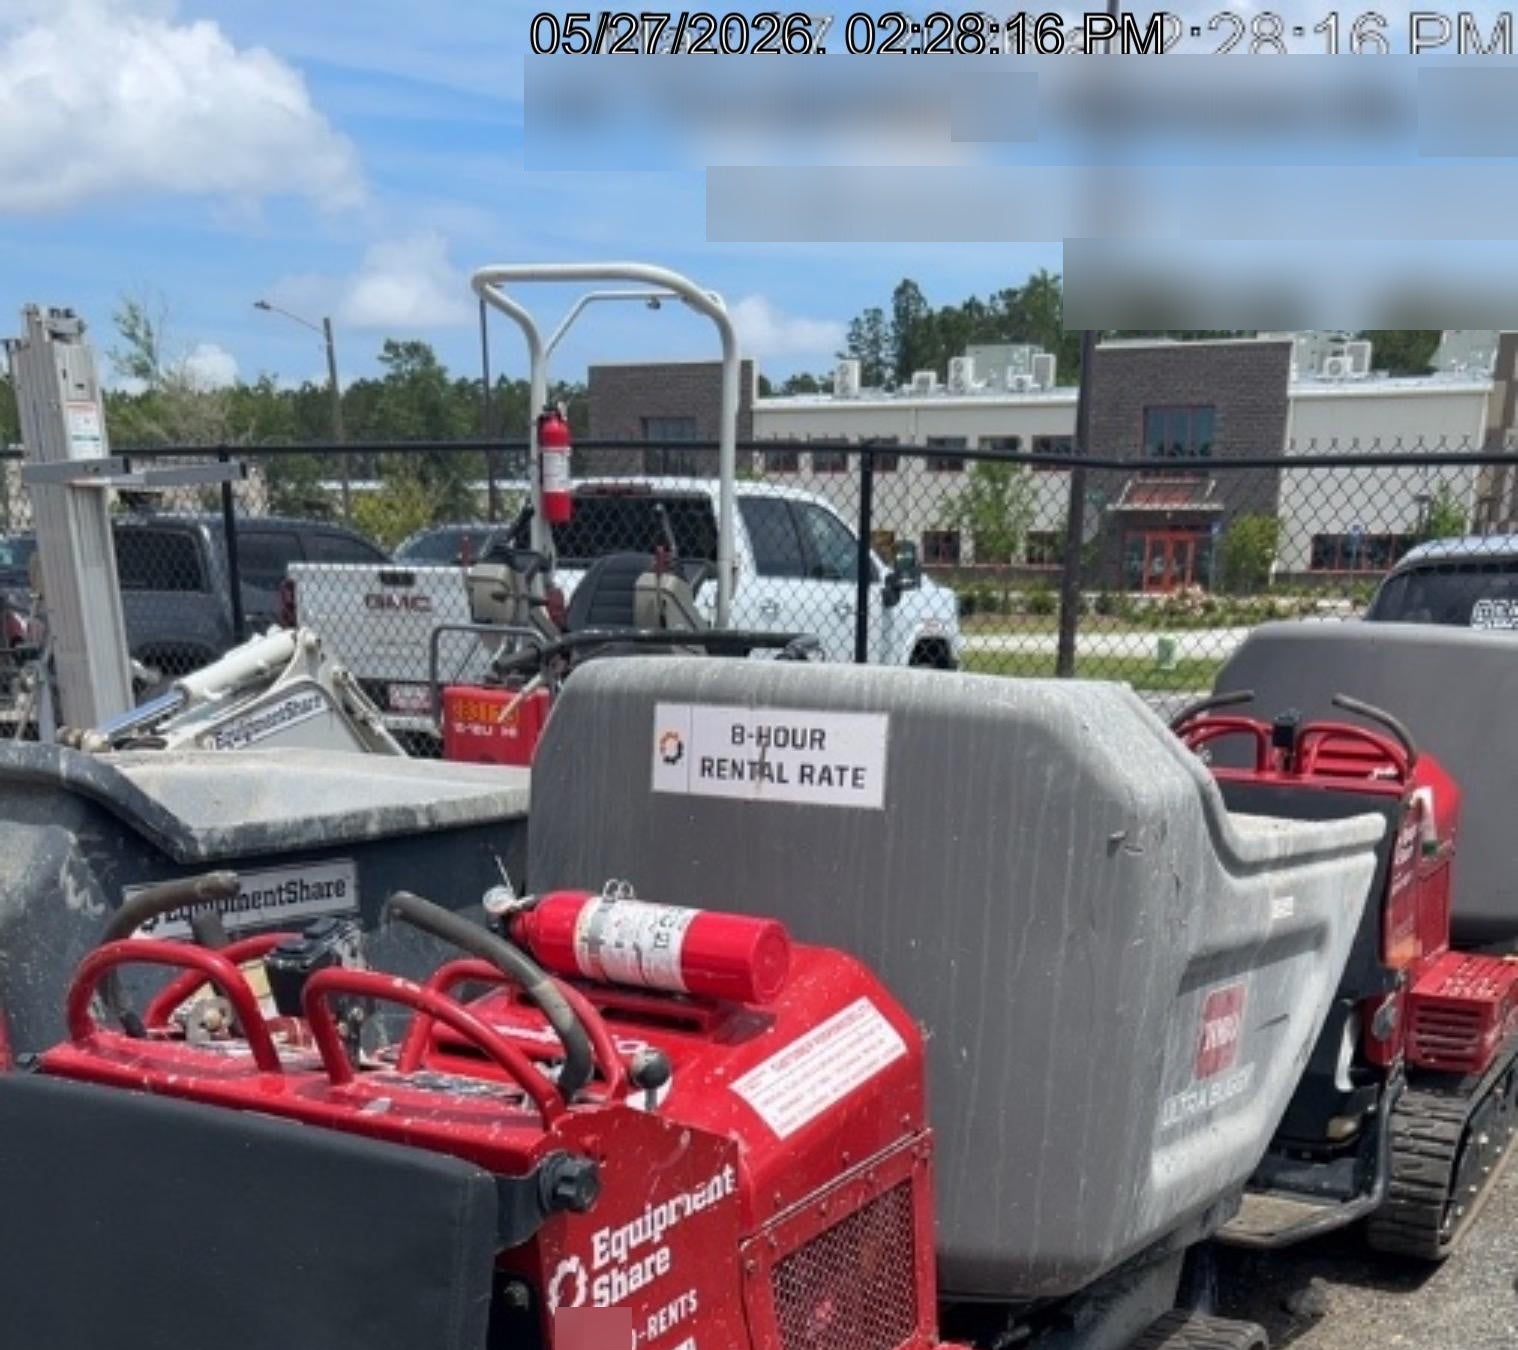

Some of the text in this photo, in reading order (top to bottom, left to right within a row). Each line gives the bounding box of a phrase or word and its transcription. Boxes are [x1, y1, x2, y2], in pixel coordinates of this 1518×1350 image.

[731, 723, 826, 751] 8-HOUR
[700, 756, 867, 790] RENTAL RATE
[591, 1163, 738, 1270] Equipment
[591, 1246, 671, 1308] Share
